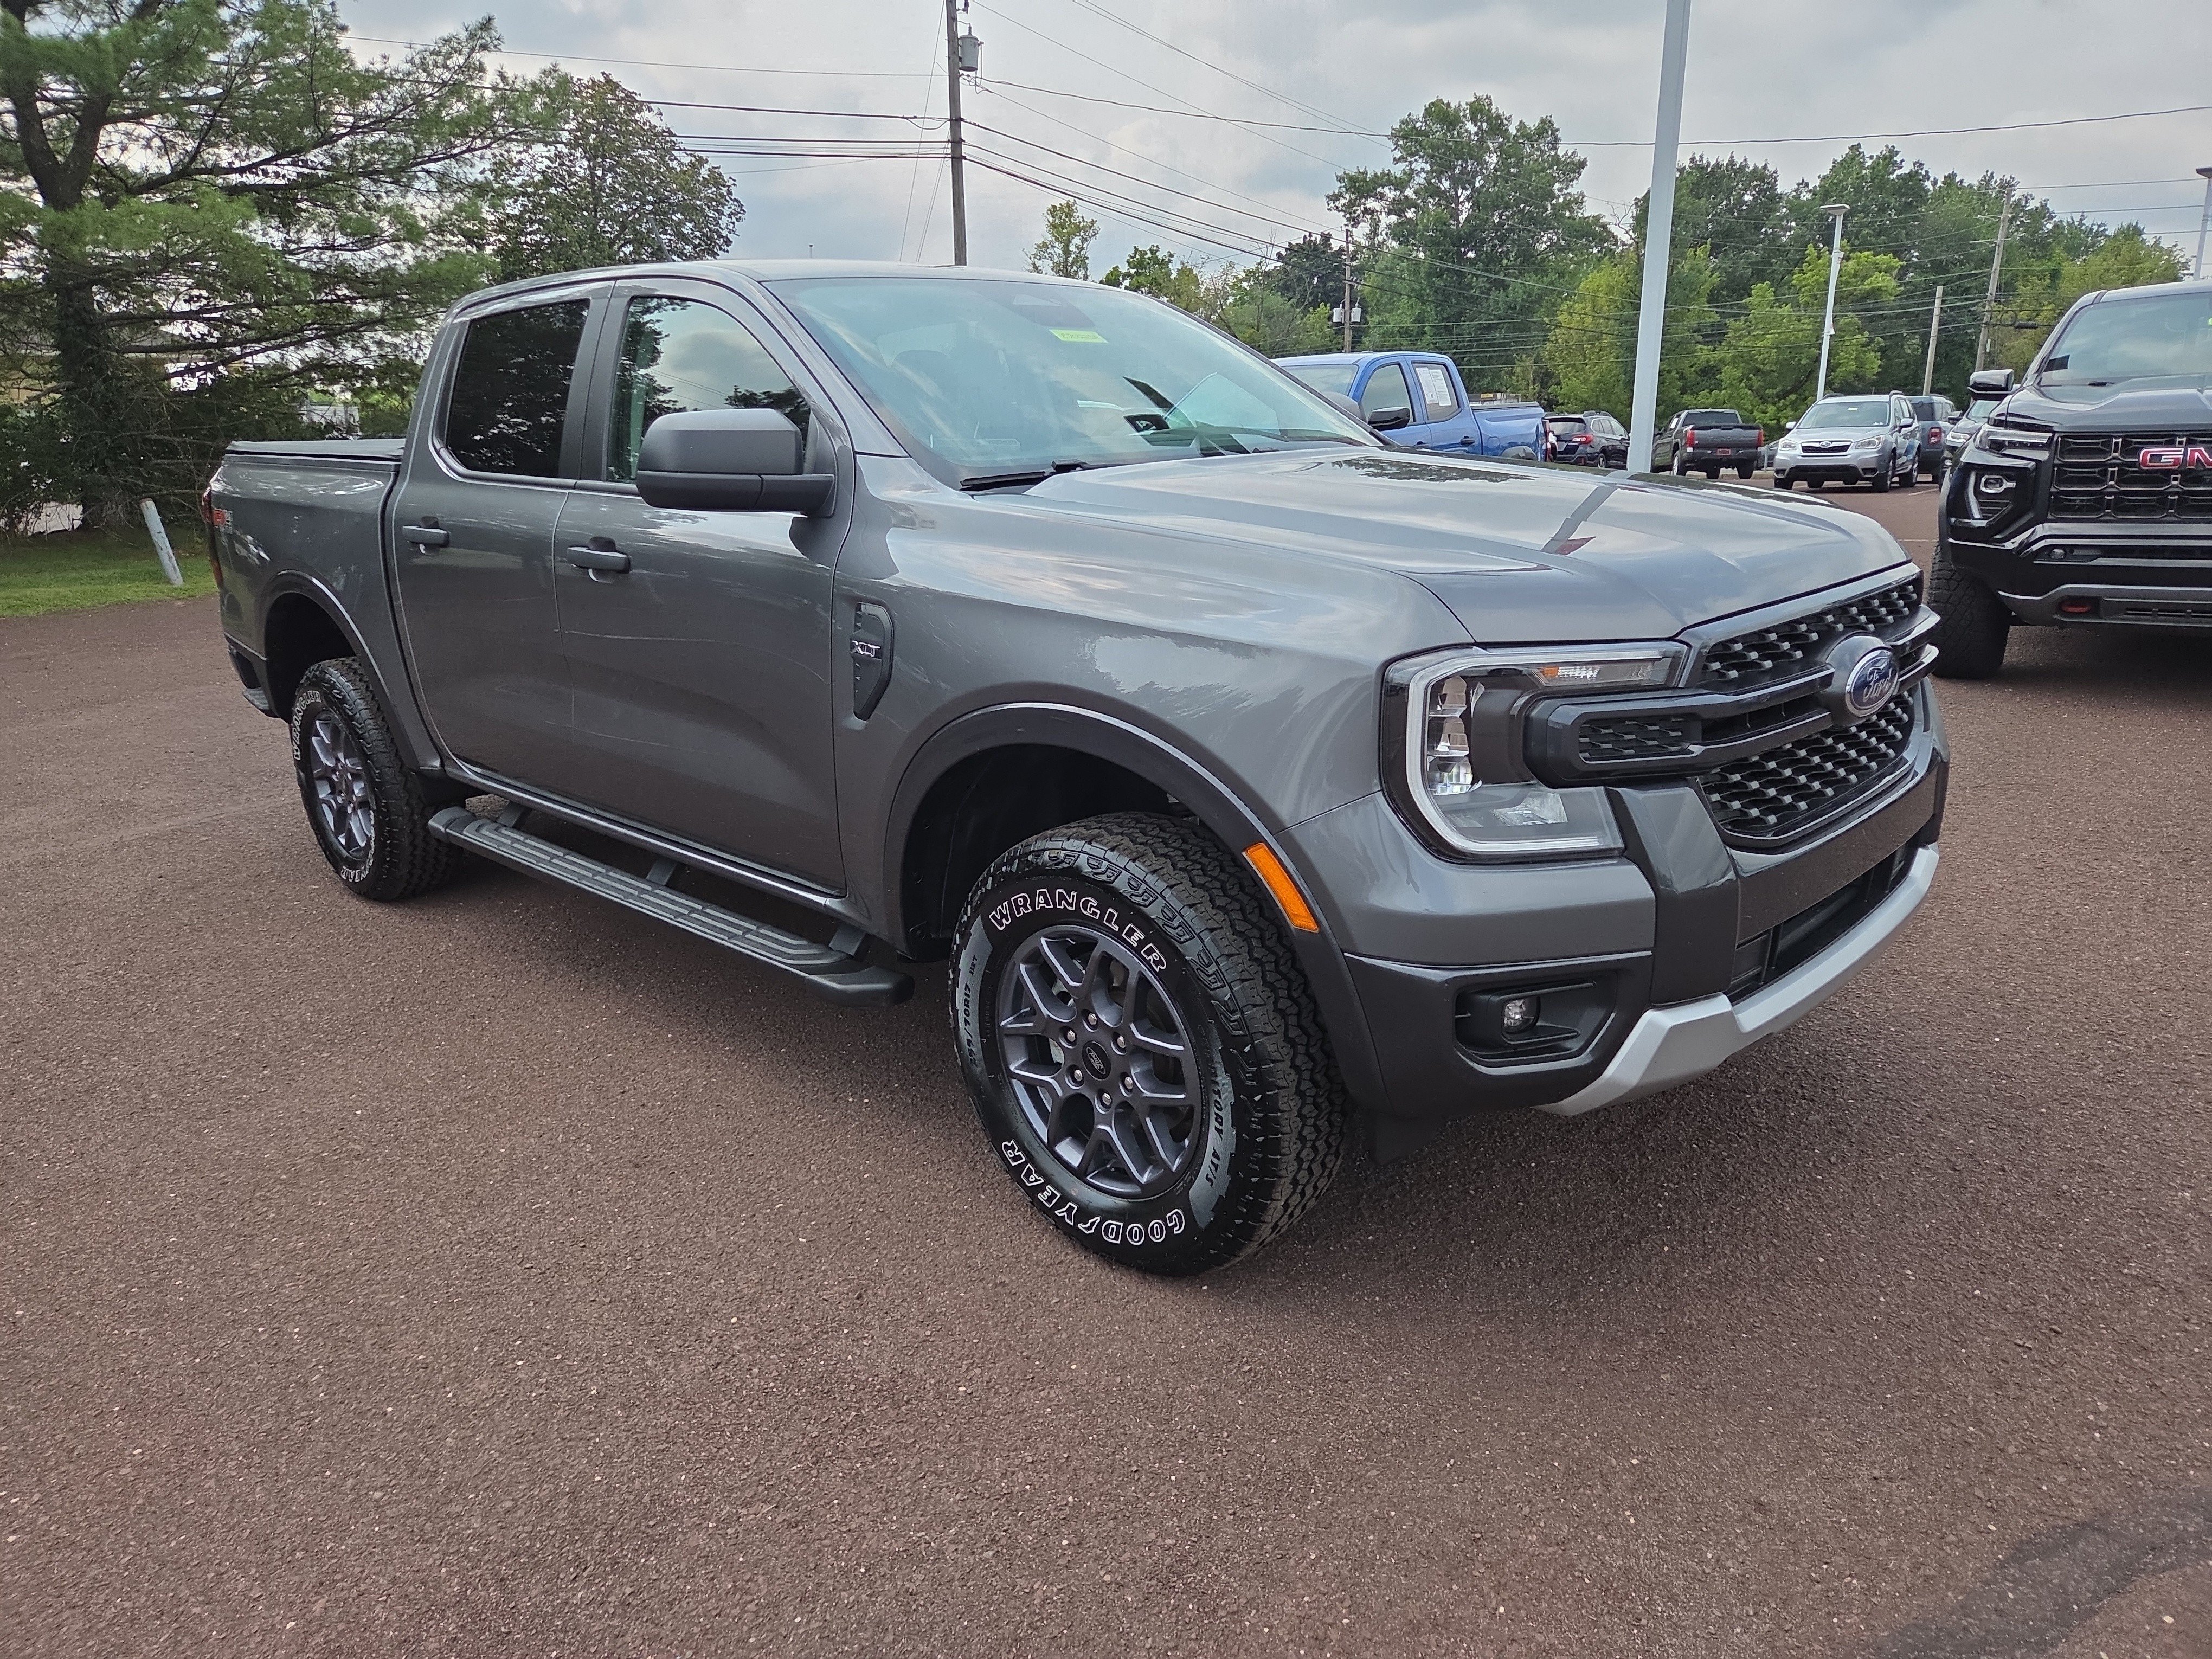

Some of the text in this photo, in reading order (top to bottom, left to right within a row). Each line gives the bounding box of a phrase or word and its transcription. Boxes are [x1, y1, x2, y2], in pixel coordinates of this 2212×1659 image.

[852, 640, 882, 658] XLT
[1863, 659, 1892, 703] Ford
[292, 690, 322, 760] WRANGLER
[988, 887, 1167, 973] WRANGLER
[1089, 1052, 1103, 1069] Ford
[1205, 1147, 1221, 1187] AT/S
[1001, 1139, 1186, 1246] GOODYEAR
